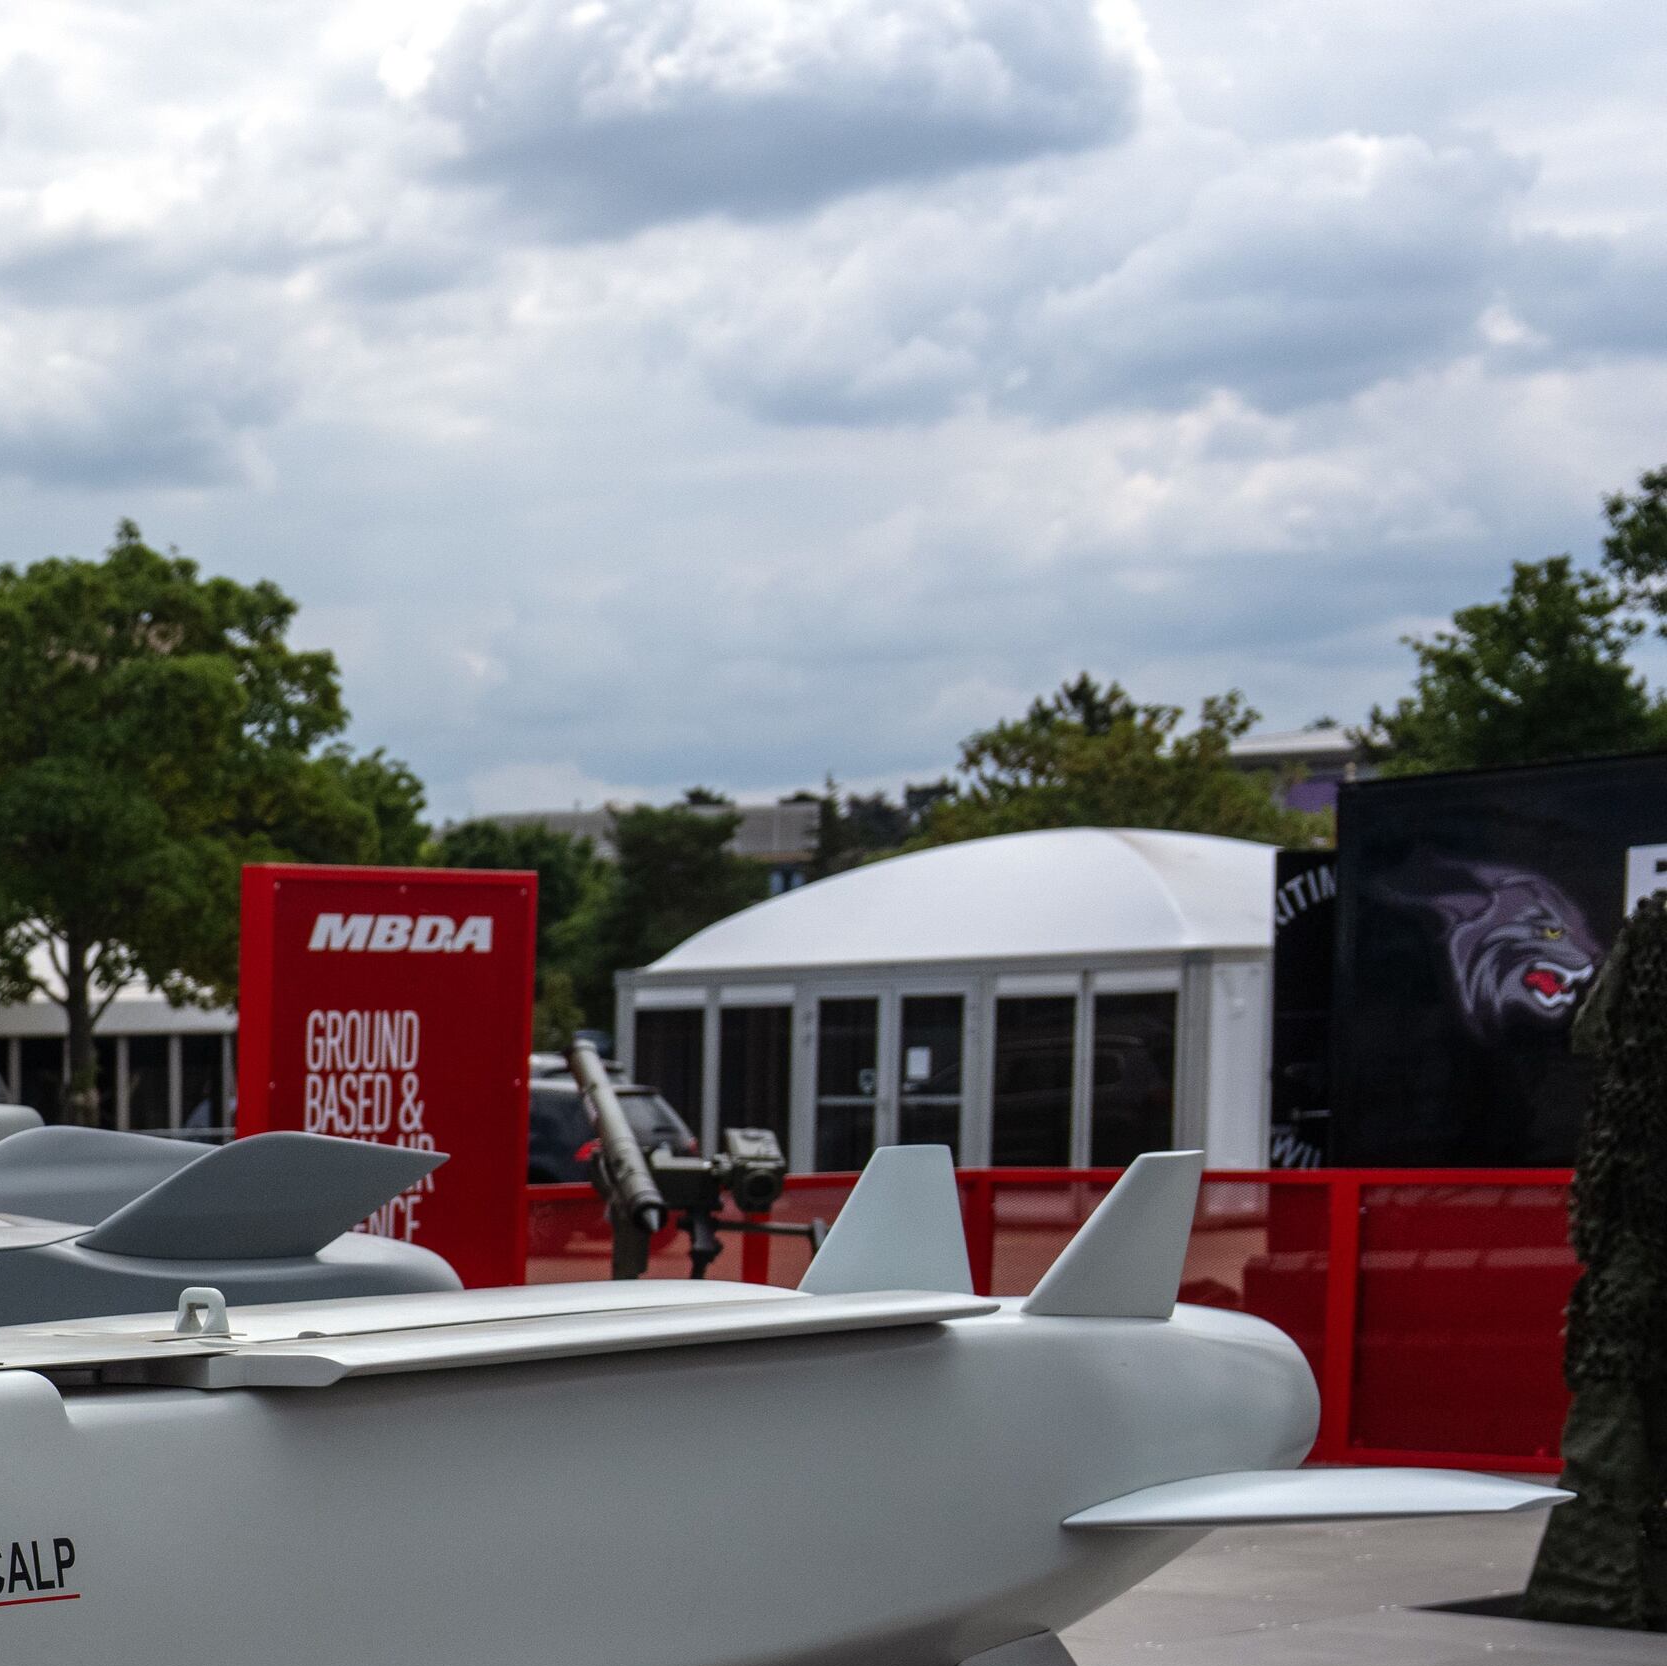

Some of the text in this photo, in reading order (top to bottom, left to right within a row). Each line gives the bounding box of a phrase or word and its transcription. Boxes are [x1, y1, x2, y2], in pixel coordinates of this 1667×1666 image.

[308, 912, 493, 954] MBDA
[305, 1009, 421, 1072] GROUND
[304, 1072, 425, 1134] BASED &
